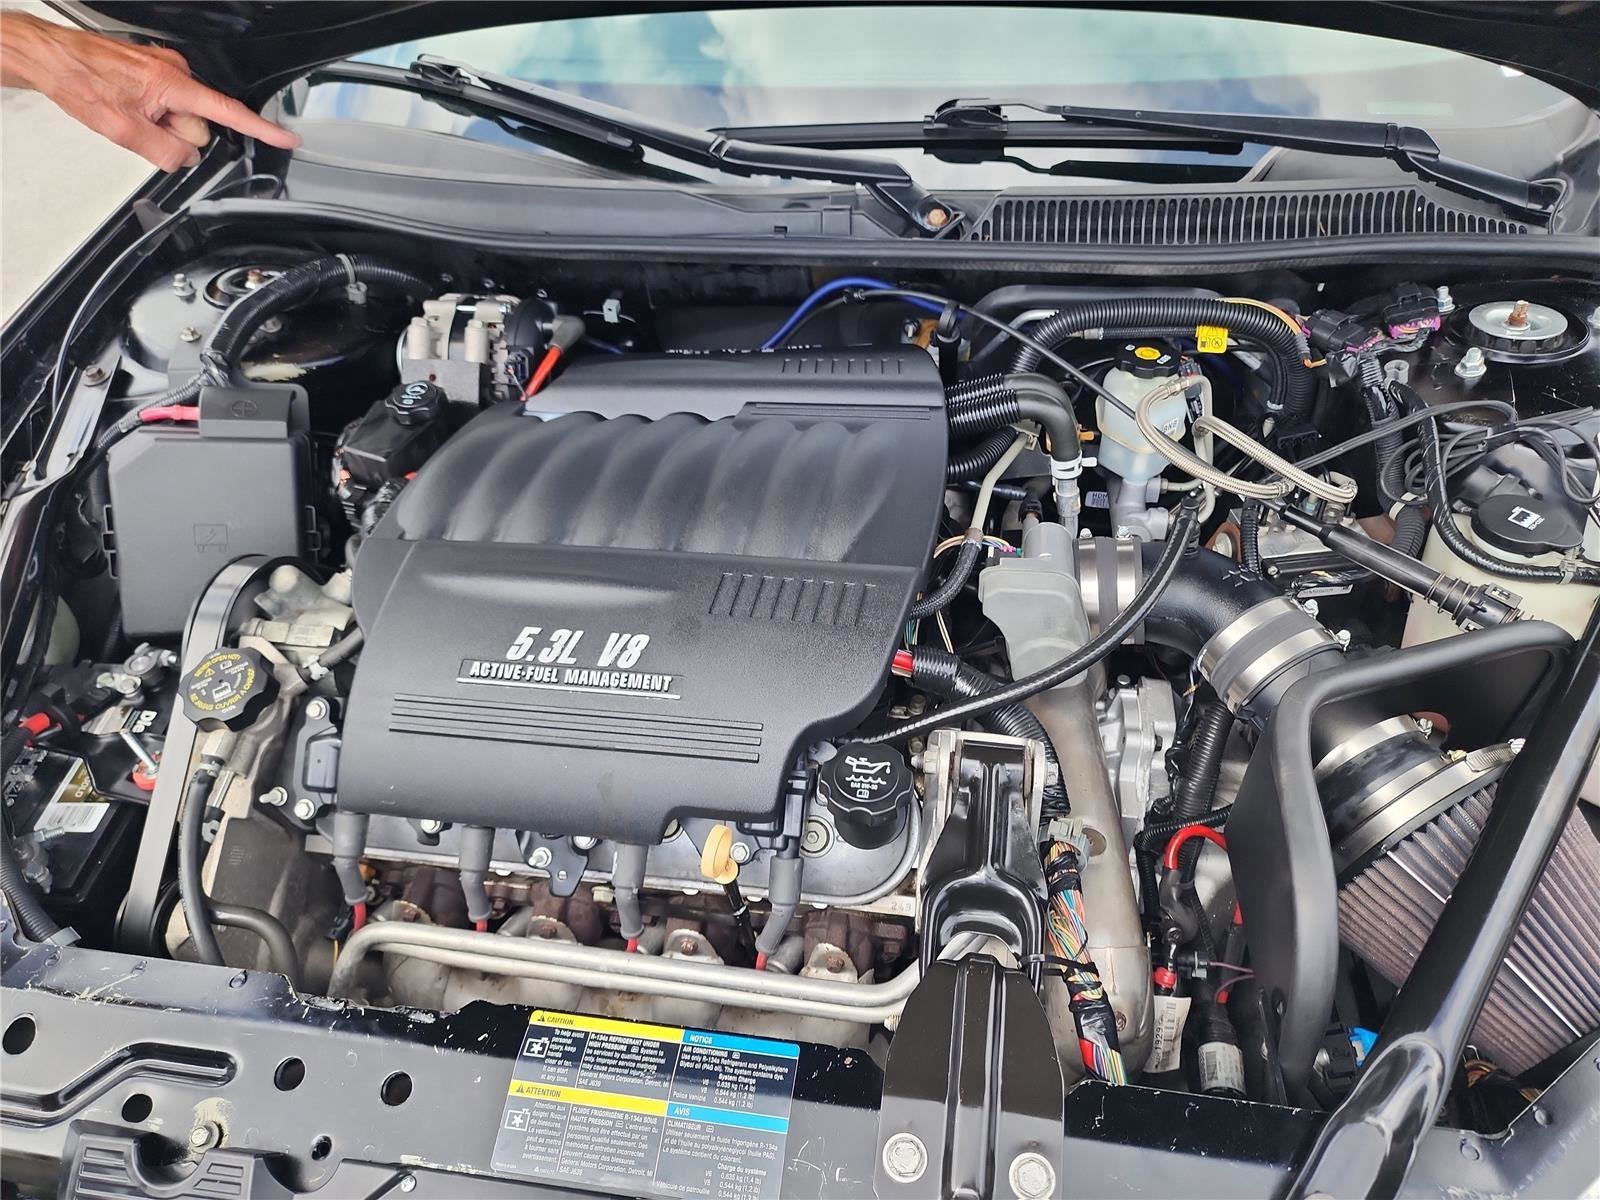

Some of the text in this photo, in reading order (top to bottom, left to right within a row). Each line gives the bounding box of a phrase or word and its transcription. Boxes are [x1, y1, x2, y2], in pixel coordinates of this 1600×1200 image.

[506, 626, 650, 668] 5.3L V8
[564, 670, 672, 691] MANAGEMENT
[547, 1016, 574, 1025] CAUTION
[609, 1036, 642, 1046] REFRIGERANT
[690, 1035, 712, 1044] NOTICE
[601, 1042, 627, 1051] PRESSURE
[640, 1047, 658, 1056] System
[693, 1047, 728, 1057] CONDITIONING
[636, 1062, 657, 1070] methods
[721, 1058, 748, 1067] Refrigerant
[759, 1063, 788, 1073] Polyalkylene
[734, 1068, 751, 1076] system
[753, 1070, 773, 1079] contains
[719, 1073, 756, 1085] System Charge
[526, 1087, 561, 1097] ATTENTION
[738, 1092, 747, 1100] (1.2
[534, 1102, 556, 1110] Attention
[572, 1106, 590, 1115] FLUIDE
[674, 1107, 690, 1116] AVIS
[588, 1117, 613, 1127] PRESSION
[667, 1120, 701, 1131] CLIMATISEUR
[567, 1133, 591, 1141] personnel
[581, 1160, 597, 1169] Motors
[718, 1163, 736, 1172] Charge
[736, 1175, 743, 1183] kg
[734, 1184, 742, 1192] kg
